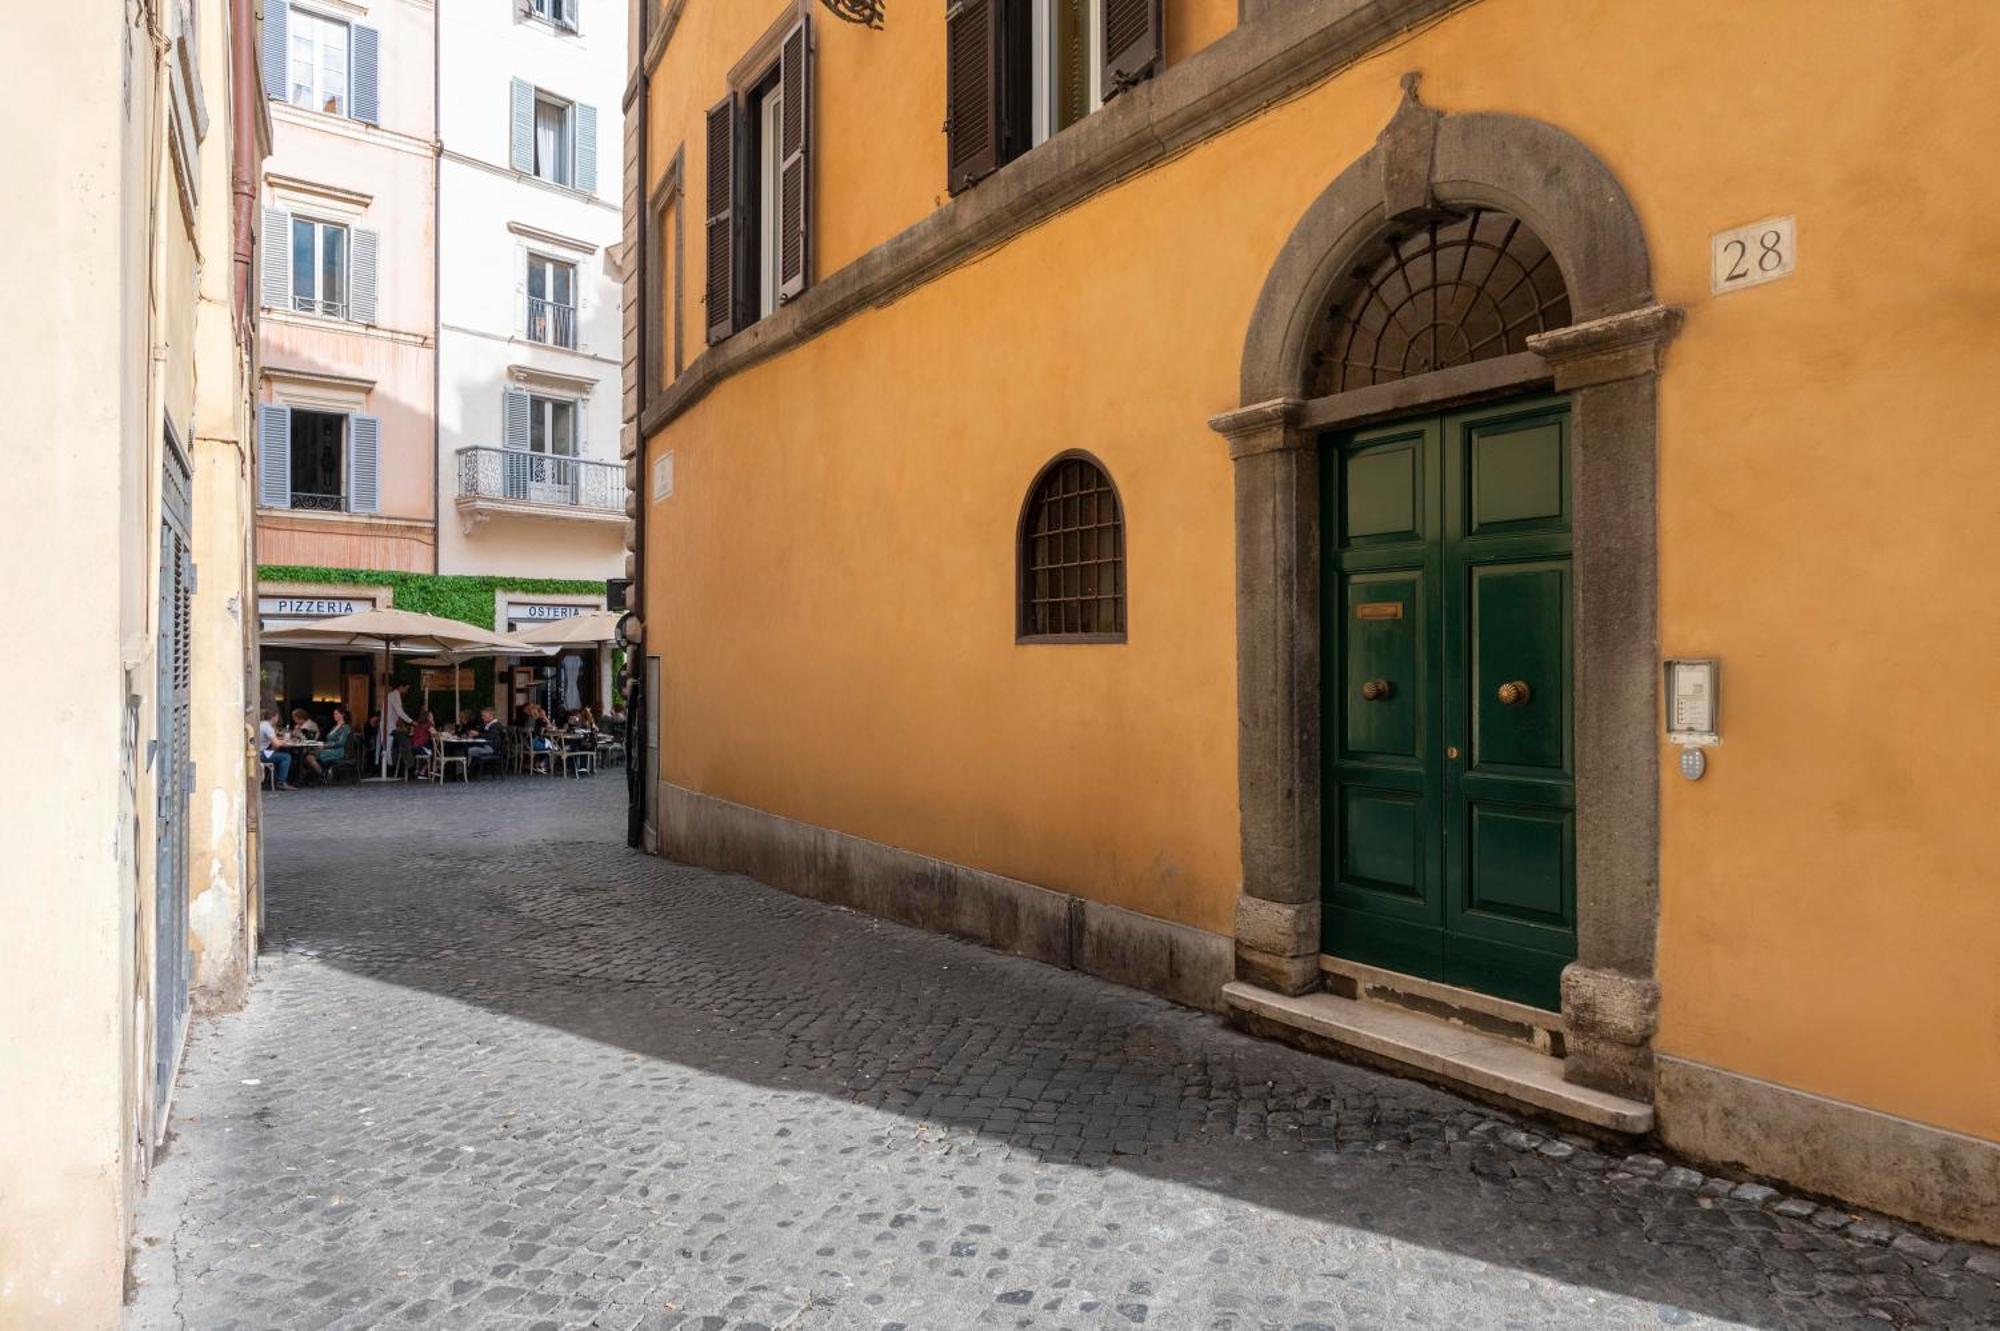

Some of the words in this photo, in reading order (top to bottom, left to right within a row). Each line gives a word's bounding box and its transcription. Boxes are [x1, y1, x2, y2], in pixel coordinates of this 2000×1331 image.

[1723, 230, 1782, 282] 28
[279, 600, 353, 613] PIZZERIA
[529, 606, 580, 617] OSTERIA
